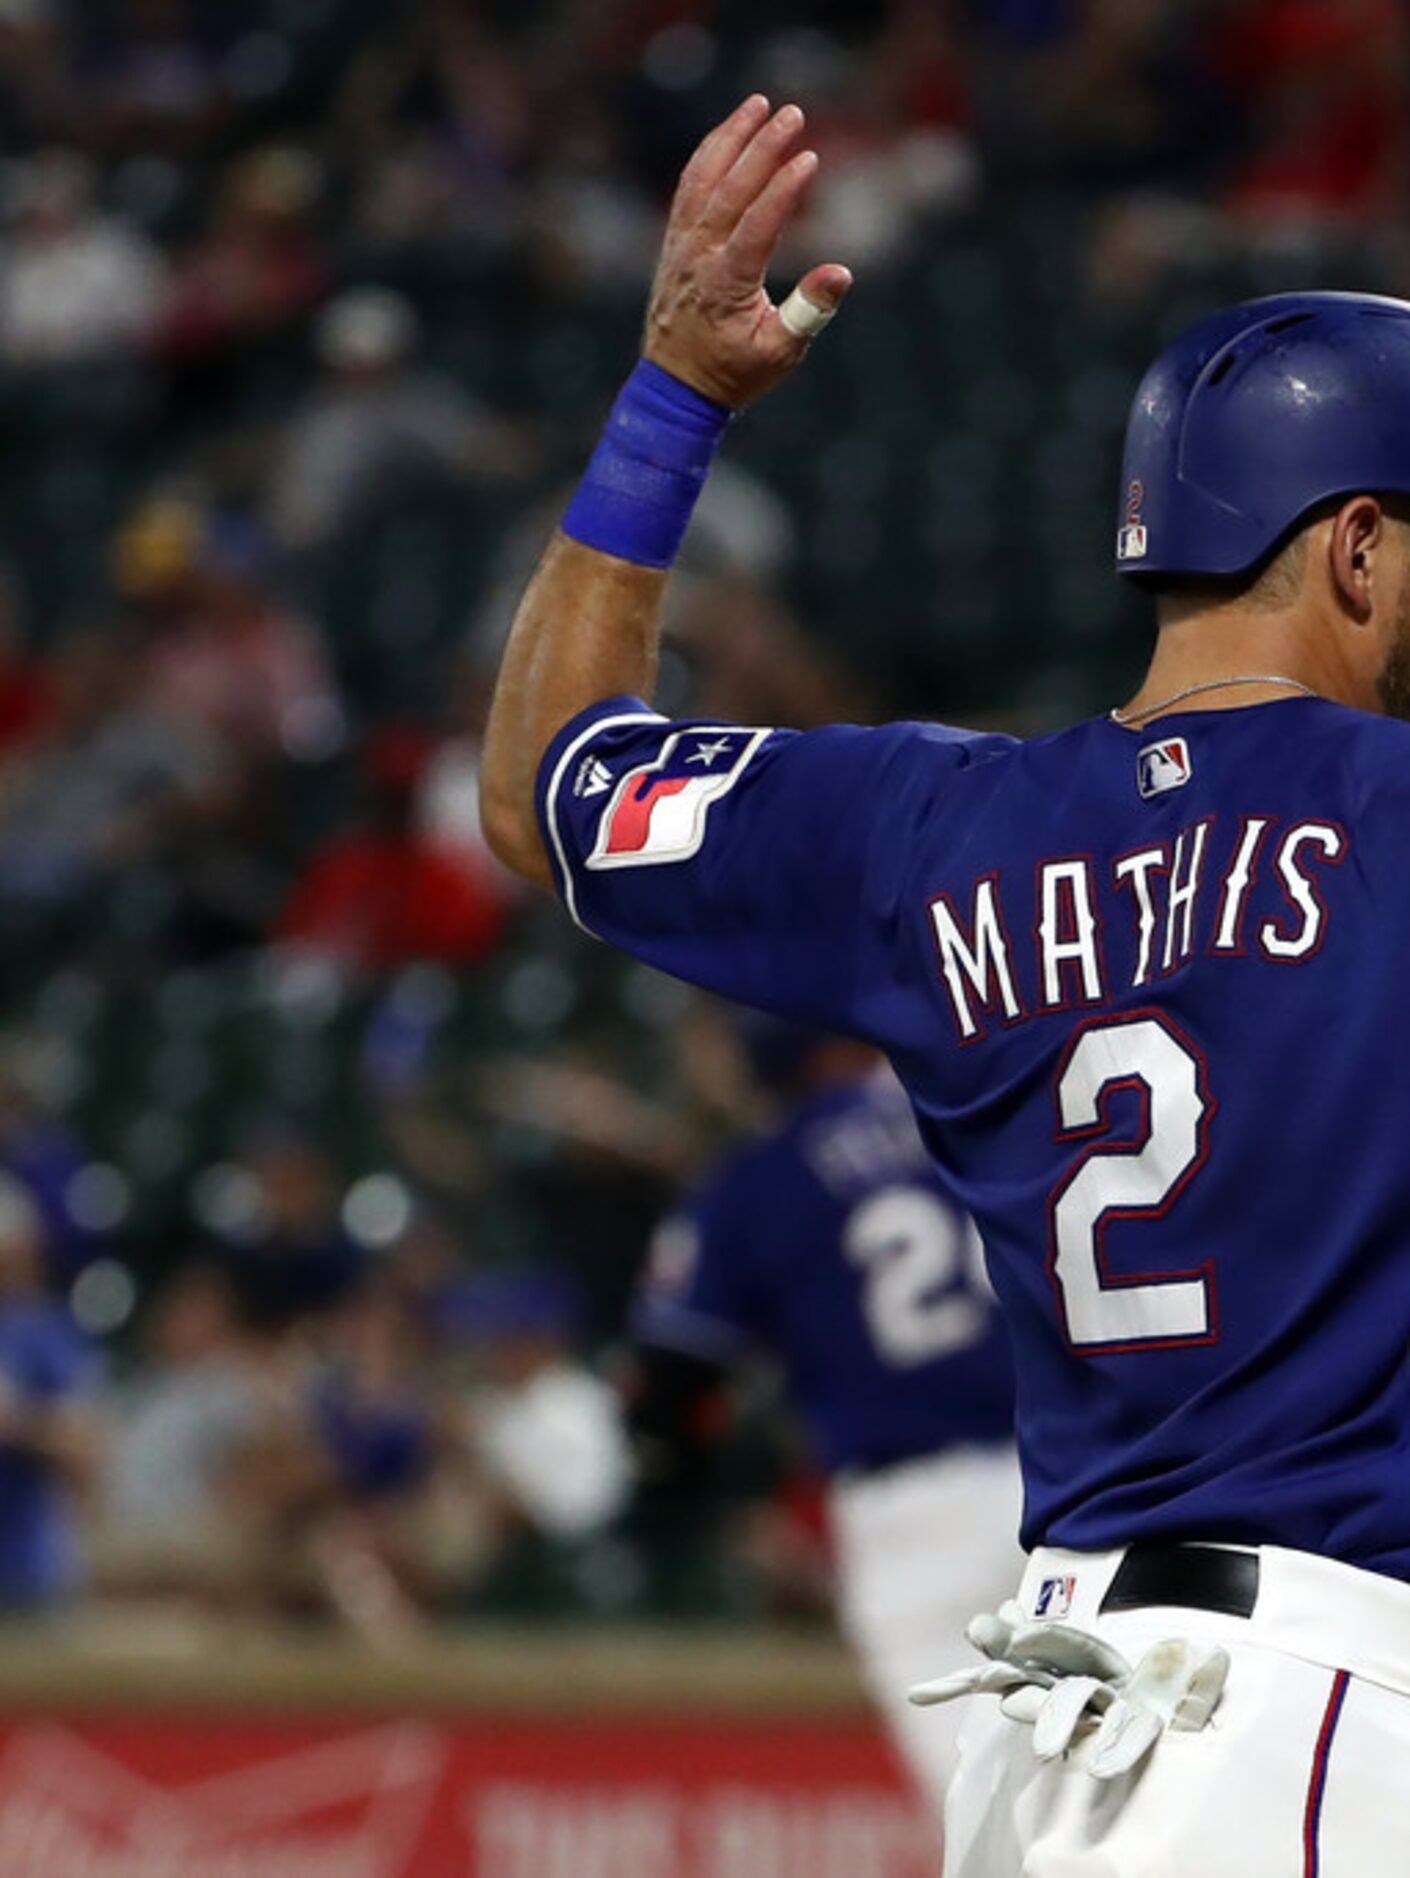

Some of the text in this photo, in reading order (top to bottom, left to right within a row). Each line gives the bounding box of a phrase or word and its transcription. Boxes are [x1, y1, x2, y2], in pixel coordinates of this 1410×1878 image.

[1126, 480, 1143, 526] 2
[929, 815, 1348, 1046] MATHIS
[845, 1185, 1000, 1370] 2
[1044, 1008, 1218, 1357] 2
